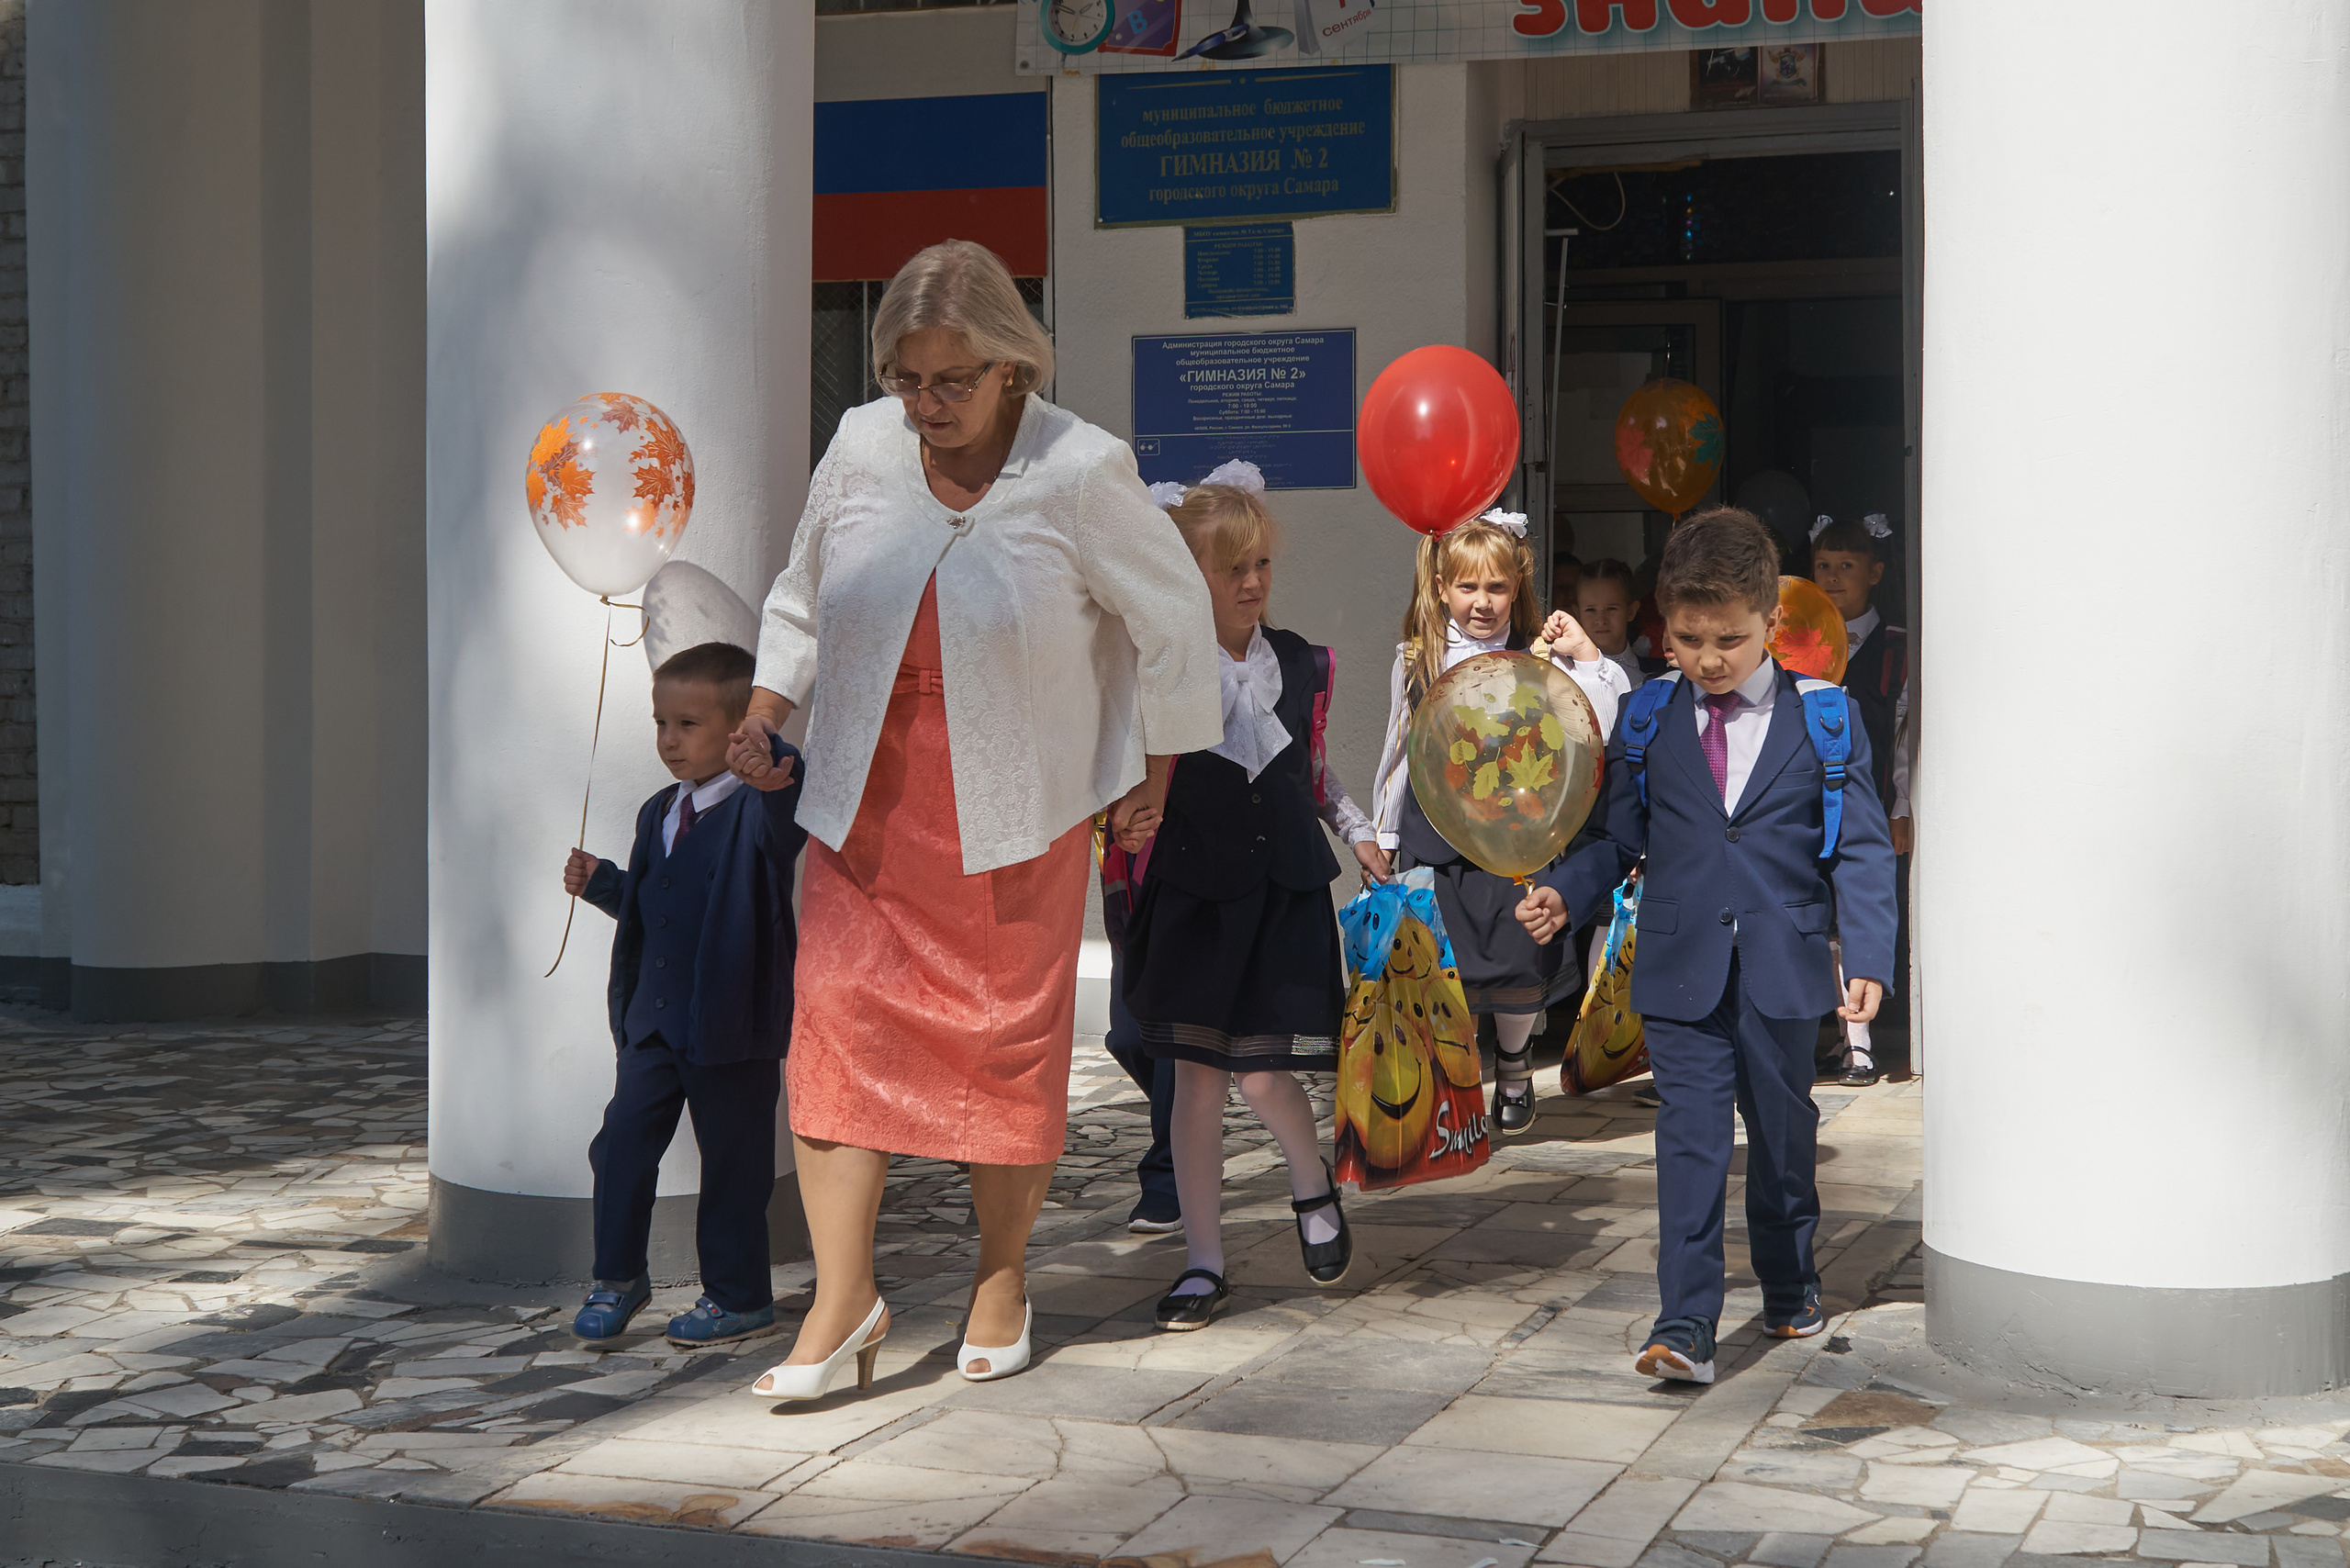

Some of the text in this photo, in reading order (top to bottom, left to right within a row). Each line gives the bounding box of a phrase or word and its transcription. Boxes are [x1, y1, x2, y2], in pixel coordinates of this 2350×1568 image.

[1322, 8, 1372, 37] сентября
[1143, 97, 1343, 127] муниципальное бюджетное
[1121, 120, 1366, 149] общеобразовательное учреждение
[1159, 147, 1328, 177] ГИМНАЗИЯ № 2
[1148, 177, 1339, 205] городского округа Самара
[1162, 336, 1325, 351] Администрация городского округа Самара
[1190, 346, 1295, 357] муниципальное бюджетное
[1176, 354, 1310, 366] общеобразовательное учреждение
[1180, 366, 1306, 383] «ГИМНАЗИЯ № 2»
[1190, 380, 1294, 392] городского округа Самара
